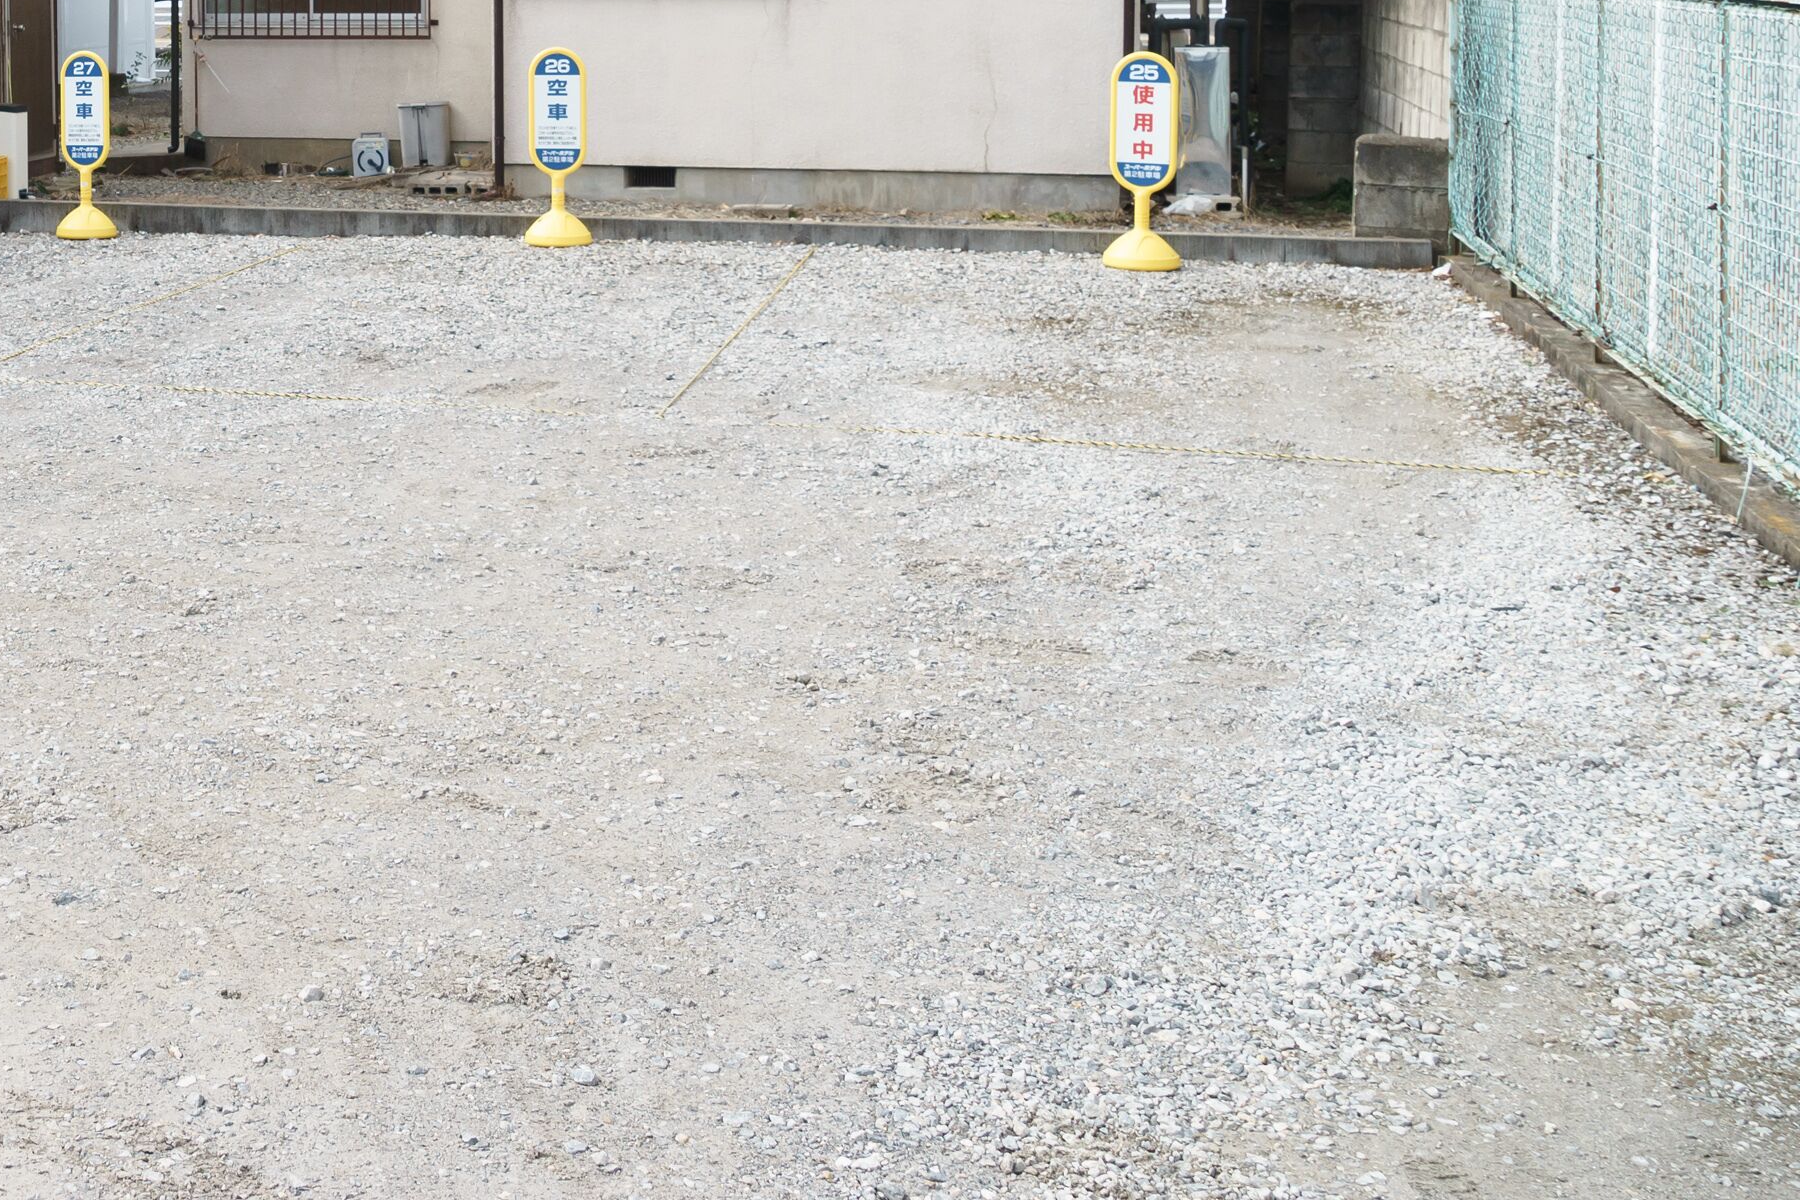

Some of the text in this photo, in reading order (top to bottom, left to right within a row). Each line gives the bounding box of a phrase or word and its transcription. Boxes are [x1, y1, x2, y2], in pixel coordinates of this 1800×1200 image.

[73, 61, 95, 75] 27
[544, 58, 570, 73] 26
[1129, 63, 1159, 81] 25
[75, 80, 93, 119] 空車
[547, 79, 568, 120] 空車
[1132, 84, 1155, 160] 使用中
[1123, 163, 1162, 171] スーパーホテル
[1123, 170, 1161, 180] 第2駐車場
